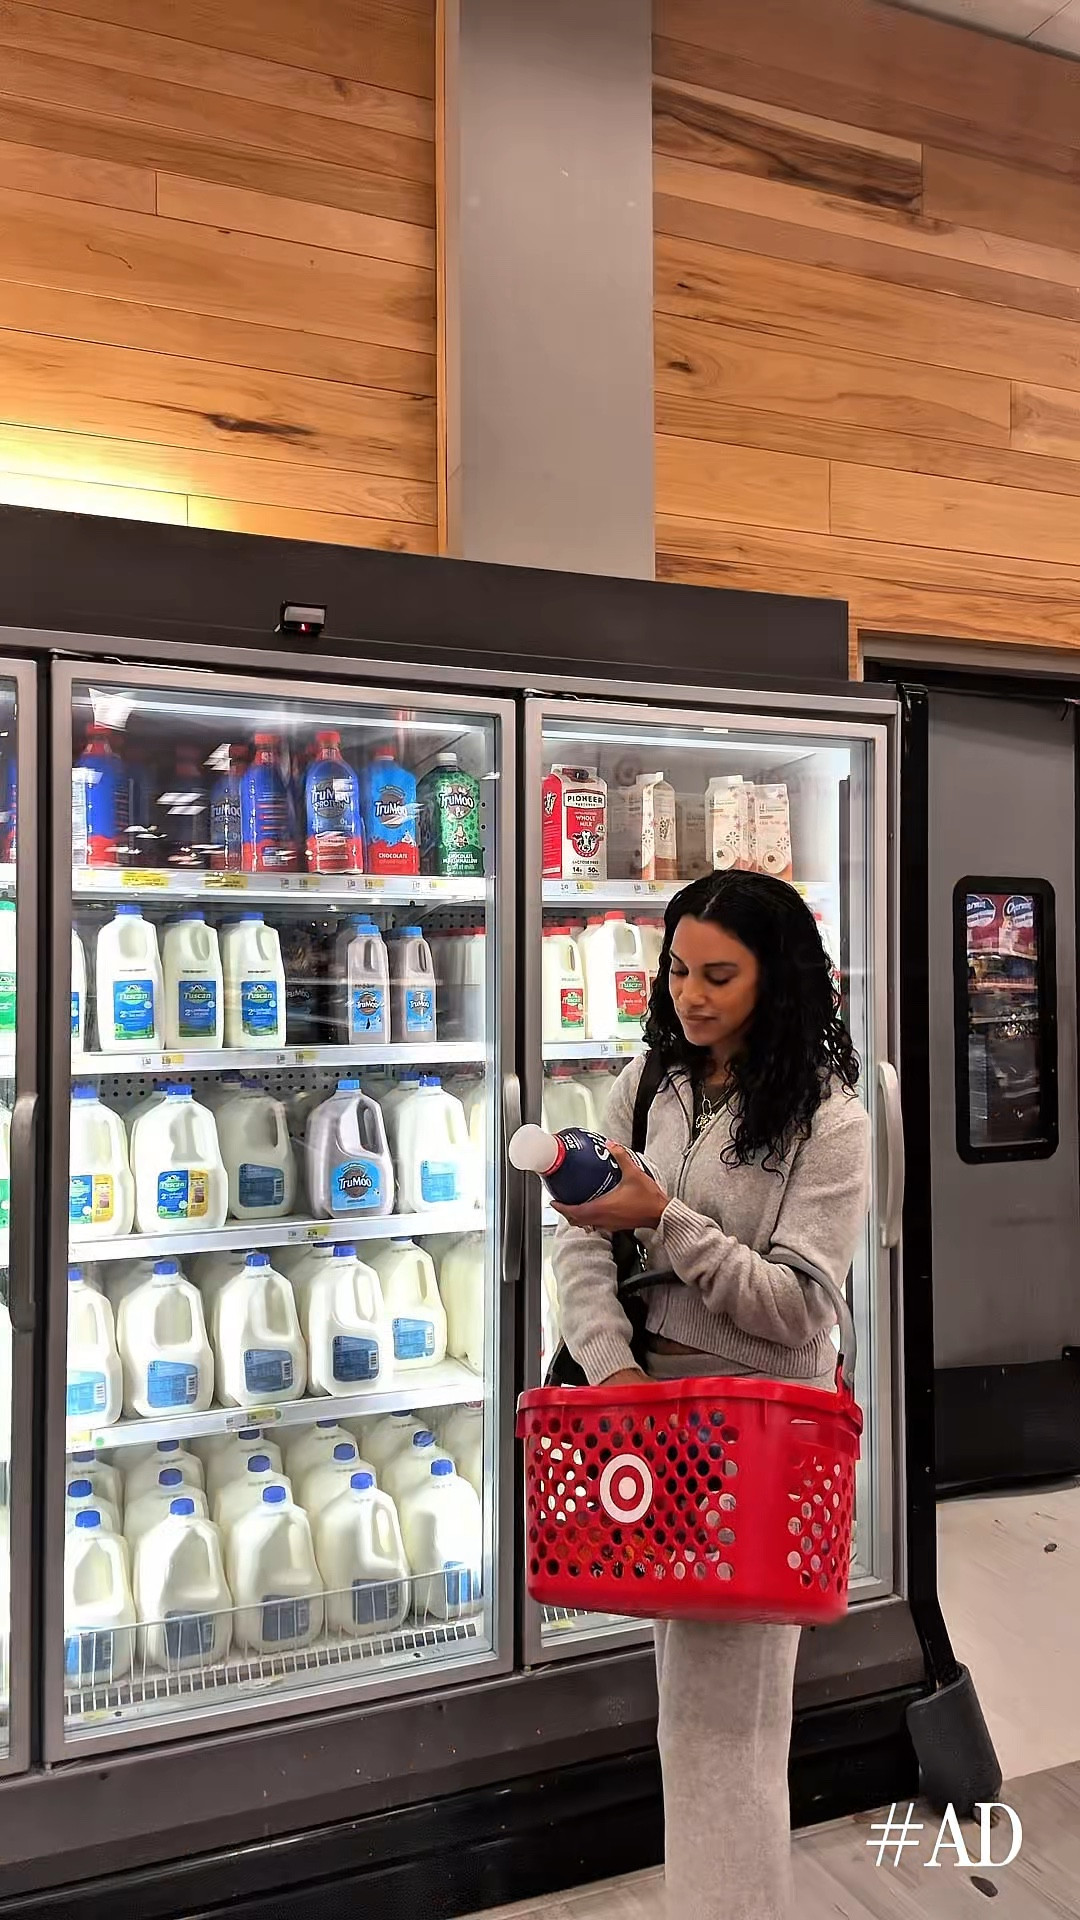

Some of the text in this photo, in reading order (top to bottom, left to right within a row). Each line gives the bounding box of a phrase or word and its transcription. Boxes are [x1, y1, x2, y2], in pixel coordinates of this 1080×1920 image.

[439, 793, 474, 808] TruMoo
[567, 795, 603, 804] PIONEER
[375, 801, 408, 817] TruMoo
[247, 992, 273, 1000] Tuscan
[338, 1176, 372, 1190] TruMoo
